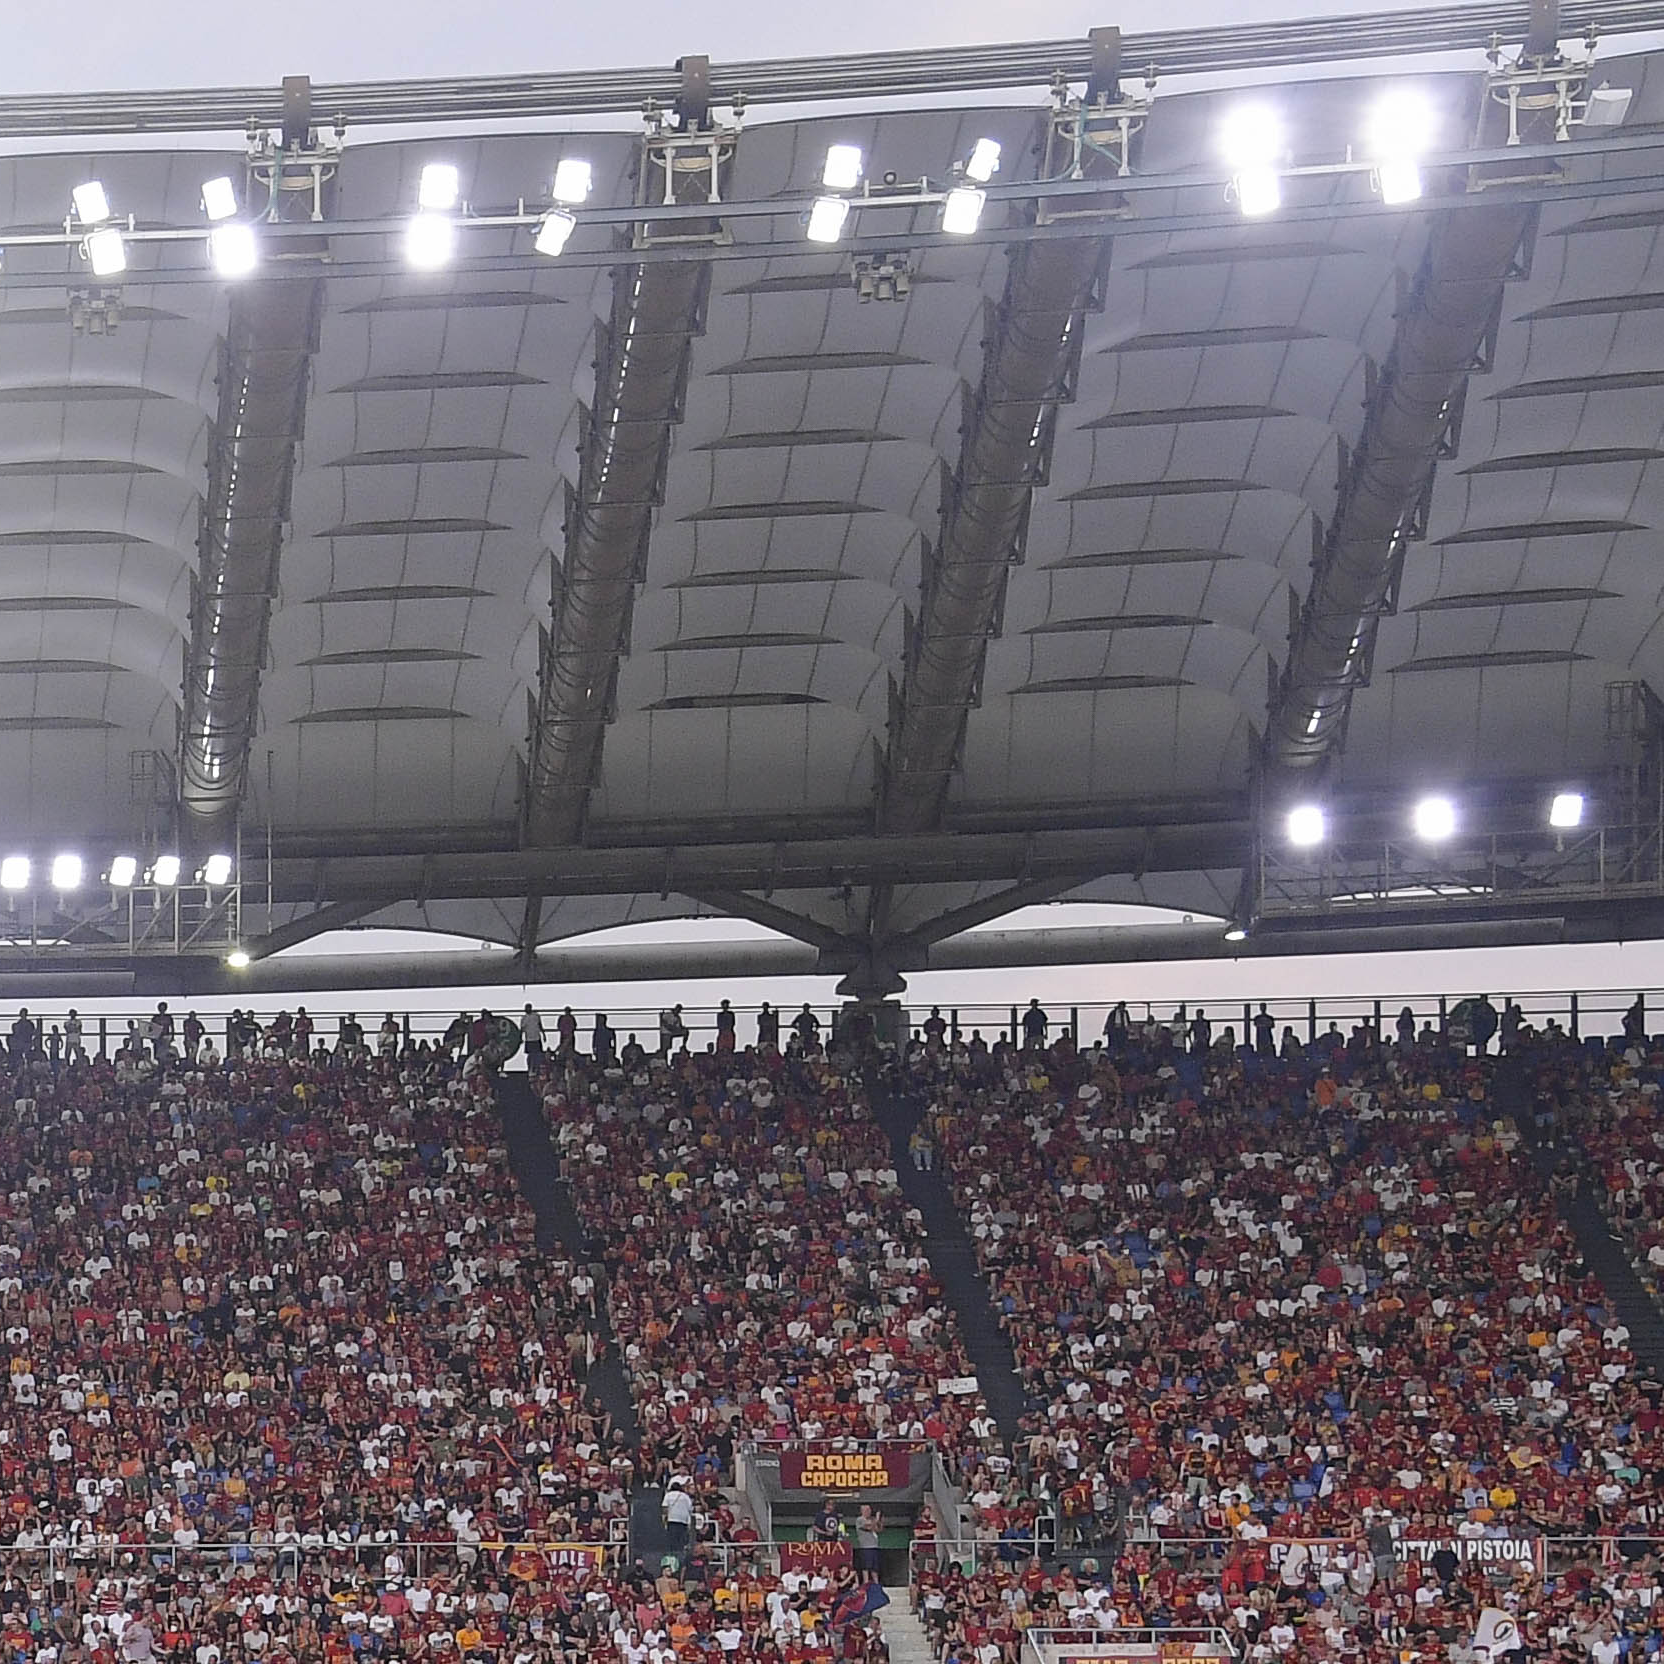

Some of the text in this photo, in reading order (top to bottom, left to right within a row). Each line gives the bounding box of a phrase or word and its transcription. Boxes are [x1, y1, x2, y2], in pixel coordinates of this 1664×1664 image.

[806, 1454, 883, 1470] ROMA
[801, 1471, 889, 1487] CAPOCCIA
[788, 1541, 846, 1556] ROMA
[1467, 1540, 1532, 1560] PISTOIA
